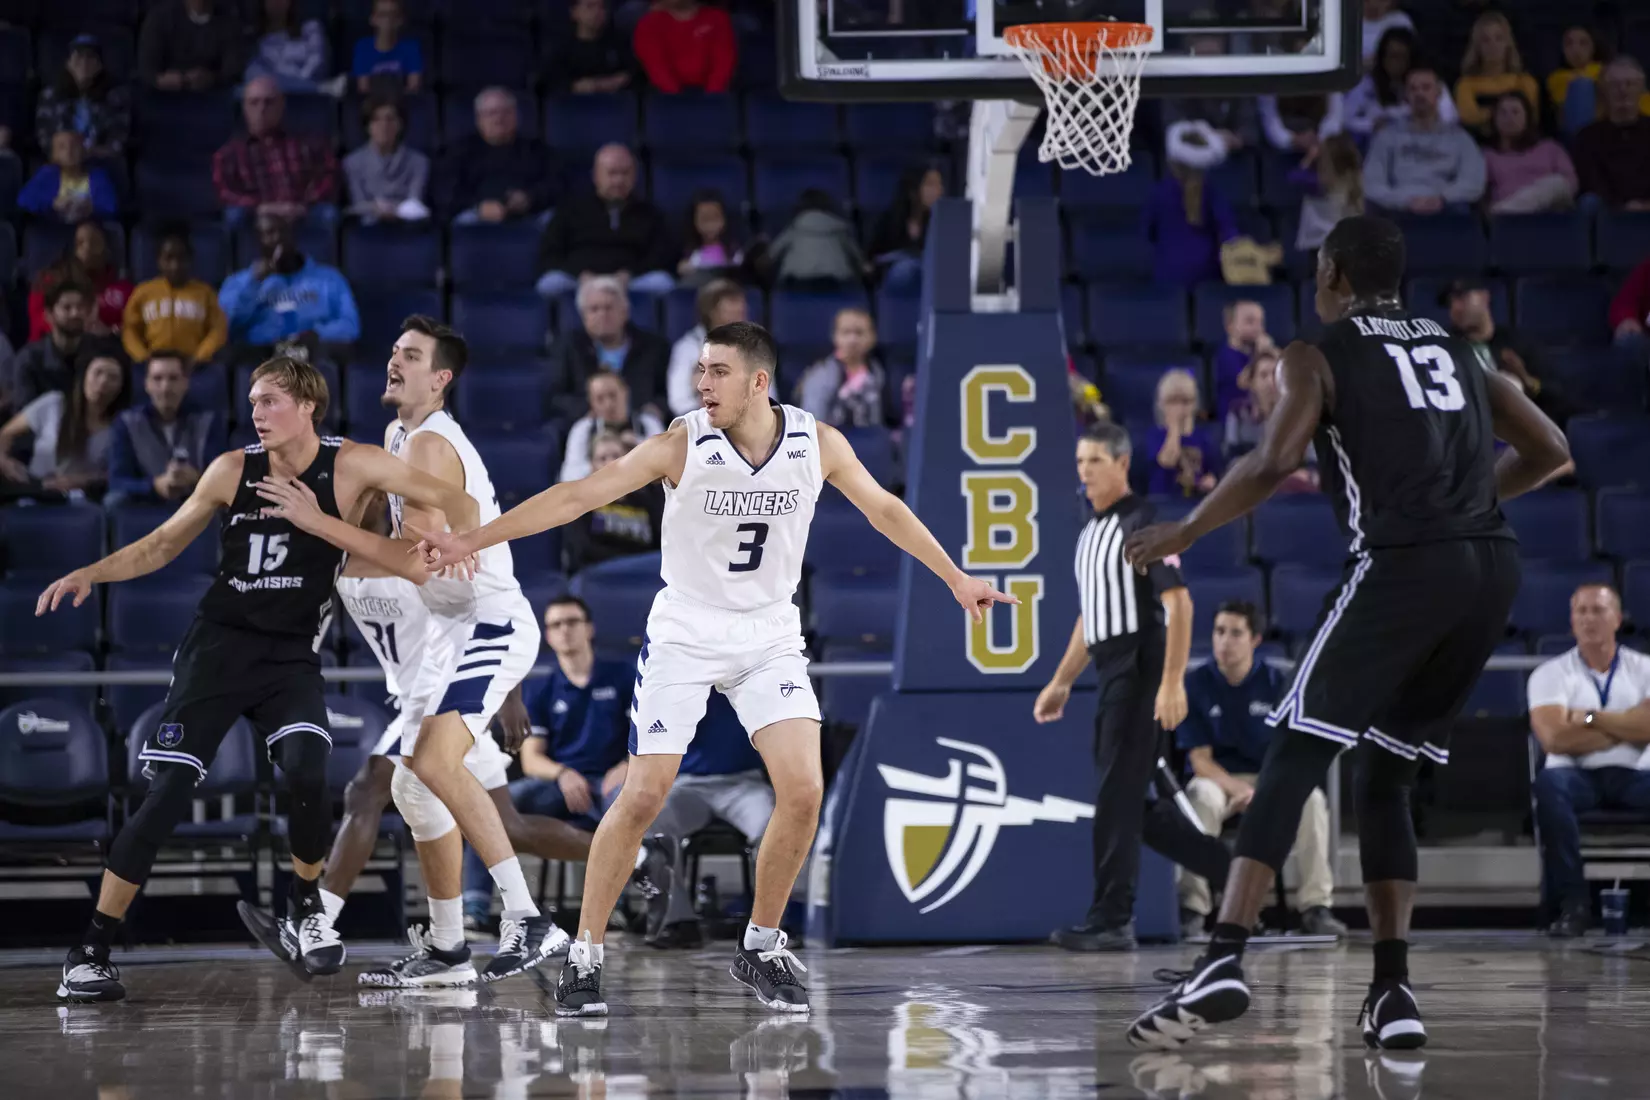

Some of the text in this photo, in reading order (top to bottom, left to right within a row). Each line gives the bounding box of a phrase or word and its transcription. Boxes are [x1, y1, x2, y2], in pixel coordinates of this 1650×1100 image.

[1383, 343, 1466, 411] 13
[787, 450, 806, 459] WAC
[704, 489, 799, 516] LANCERS
[959, 364, 1044, 674] CBU
[247, 532, 290, 575] 15
[728, 522, 769, 572] 3
[362, 620, 400, 664] 31
